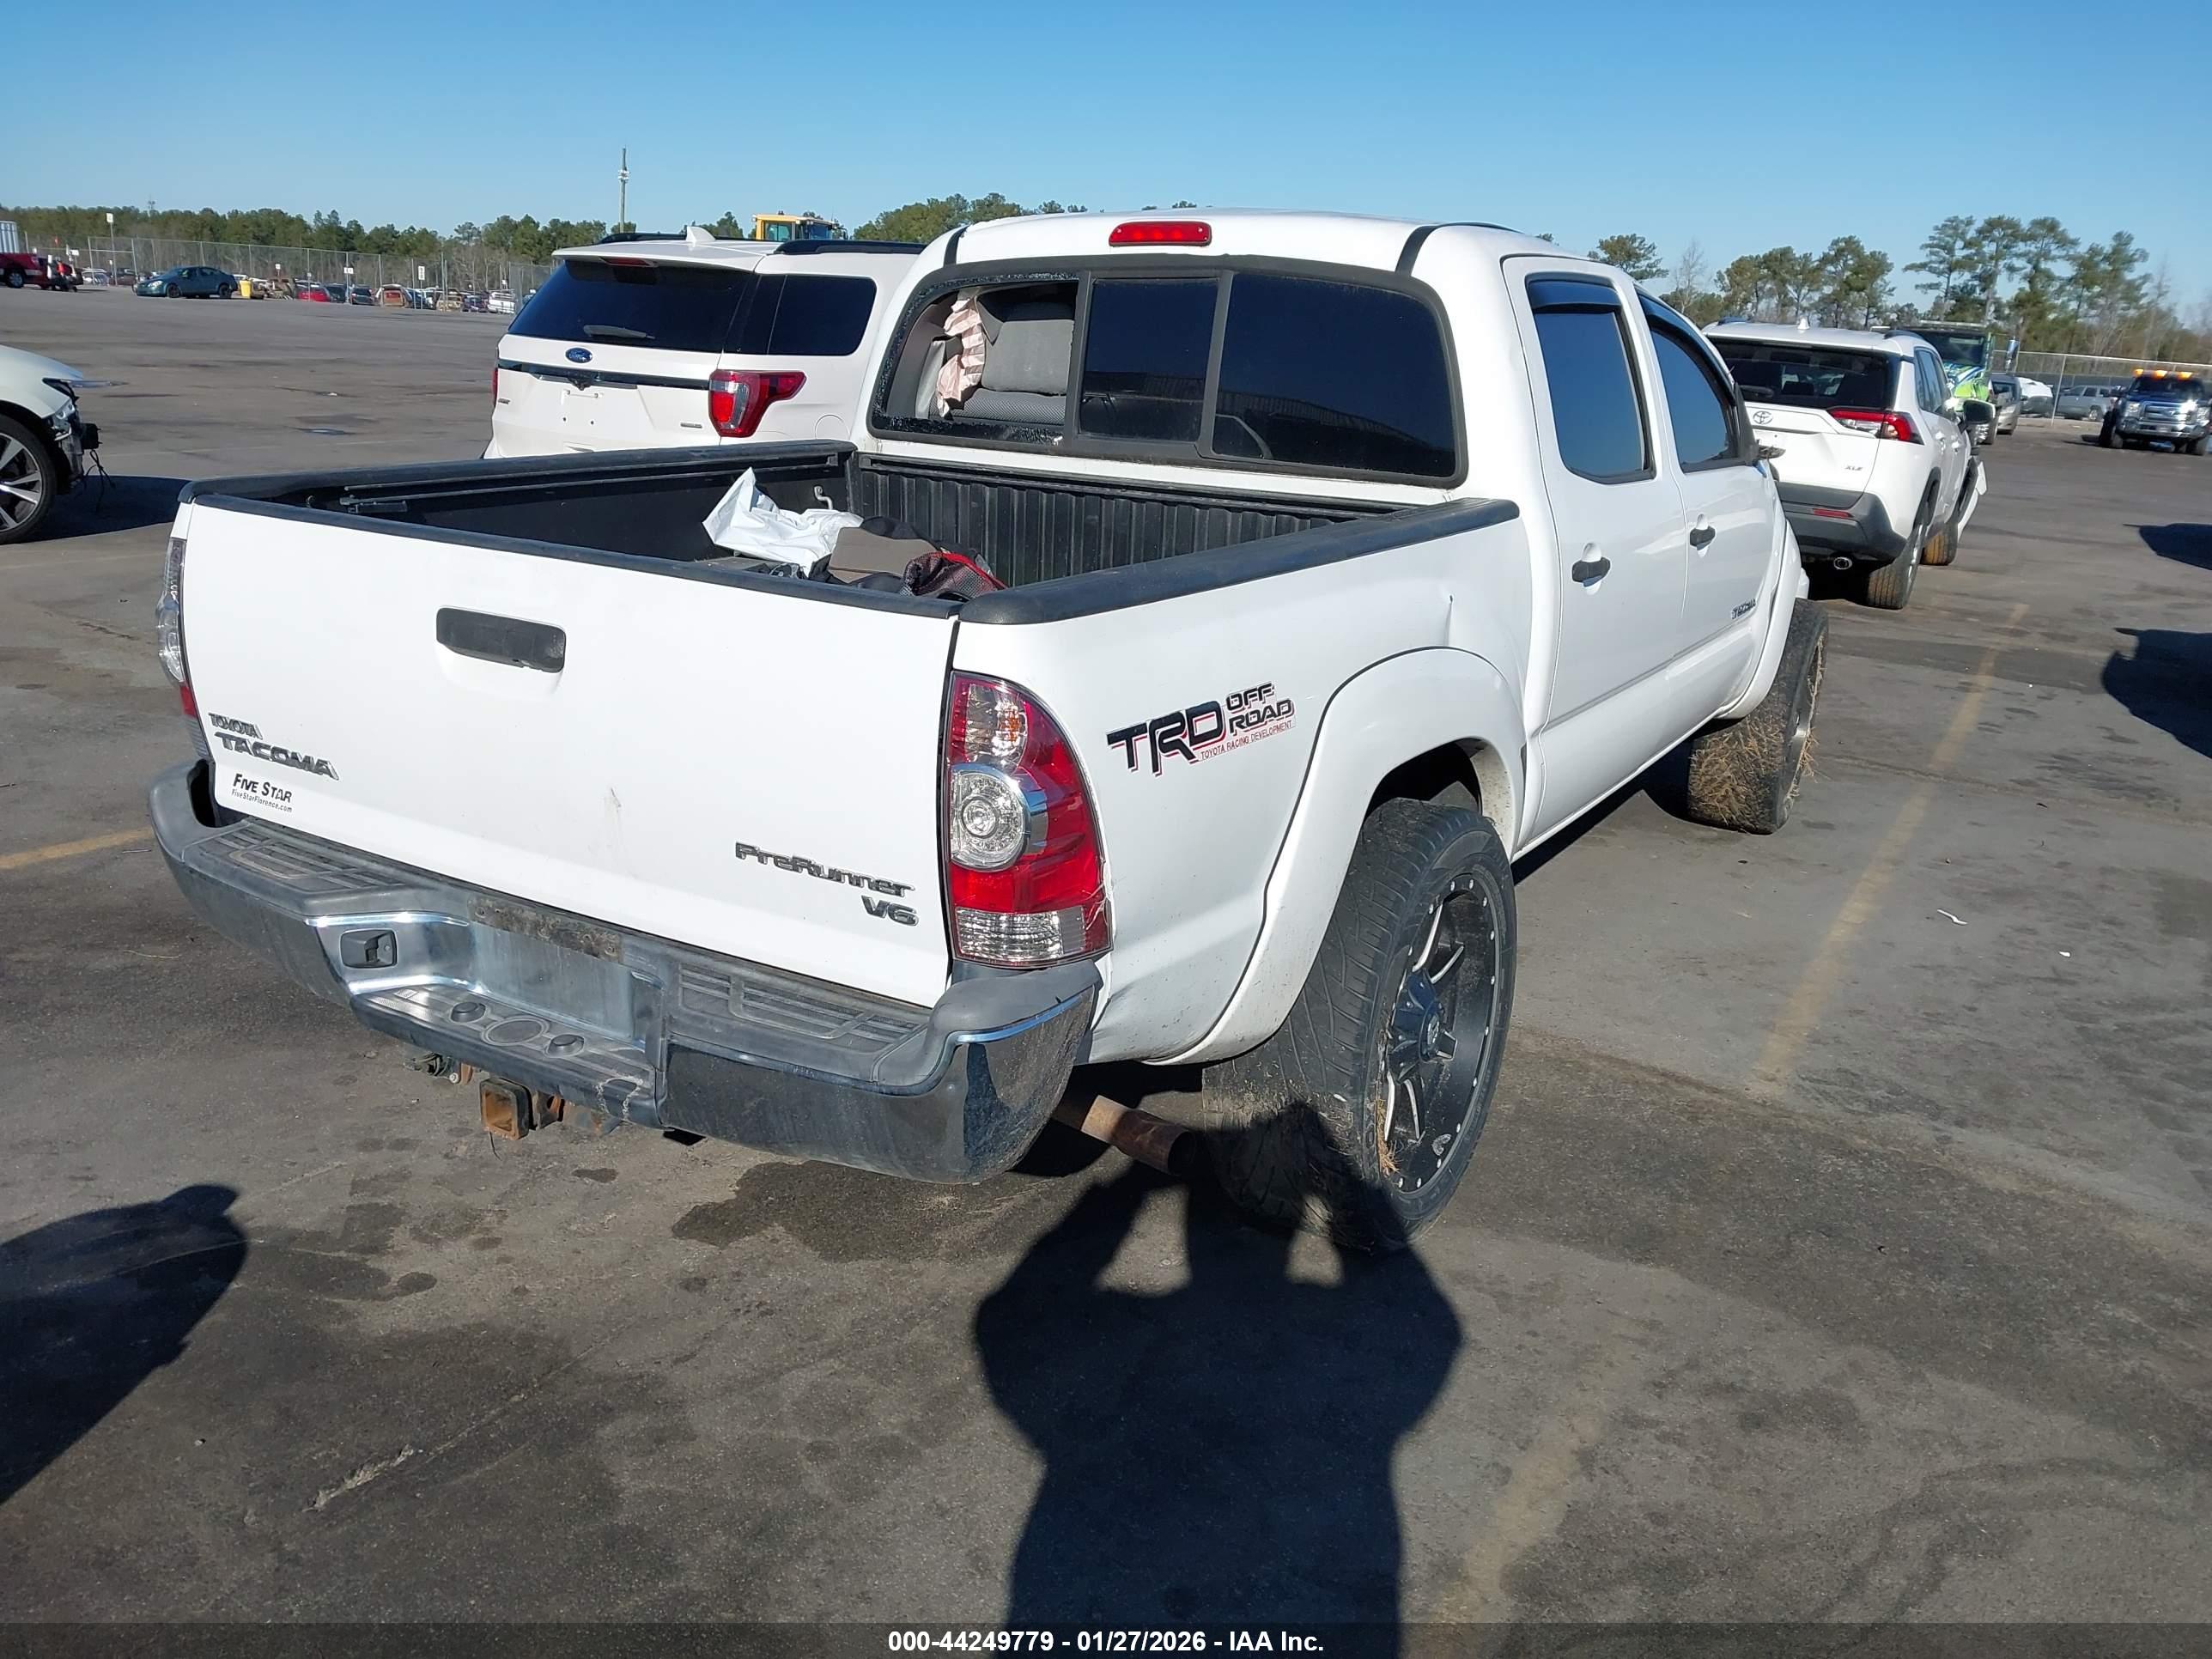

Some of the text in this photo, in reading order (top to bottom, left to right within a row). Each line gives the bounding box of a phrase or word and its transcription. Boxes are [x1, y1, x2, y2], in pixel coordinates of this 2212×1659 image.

[1226, 682, 1274, 714] OFF
[208, 713, 263, 739] TOYOTA
[1229, 699, 1294, 735] ROAD
[215, 732, 339, 781] TACOMA
[1107, 701, 1225, 776] TRD
[1200, 720, 1291, 760] TOYOTA RACING DEVELOPMENT
[231, 789, 293, 813] FiveStarFlorence.com
[735, 841, 916, 897] PreRunner
[861, 895, 920, 927] V6
